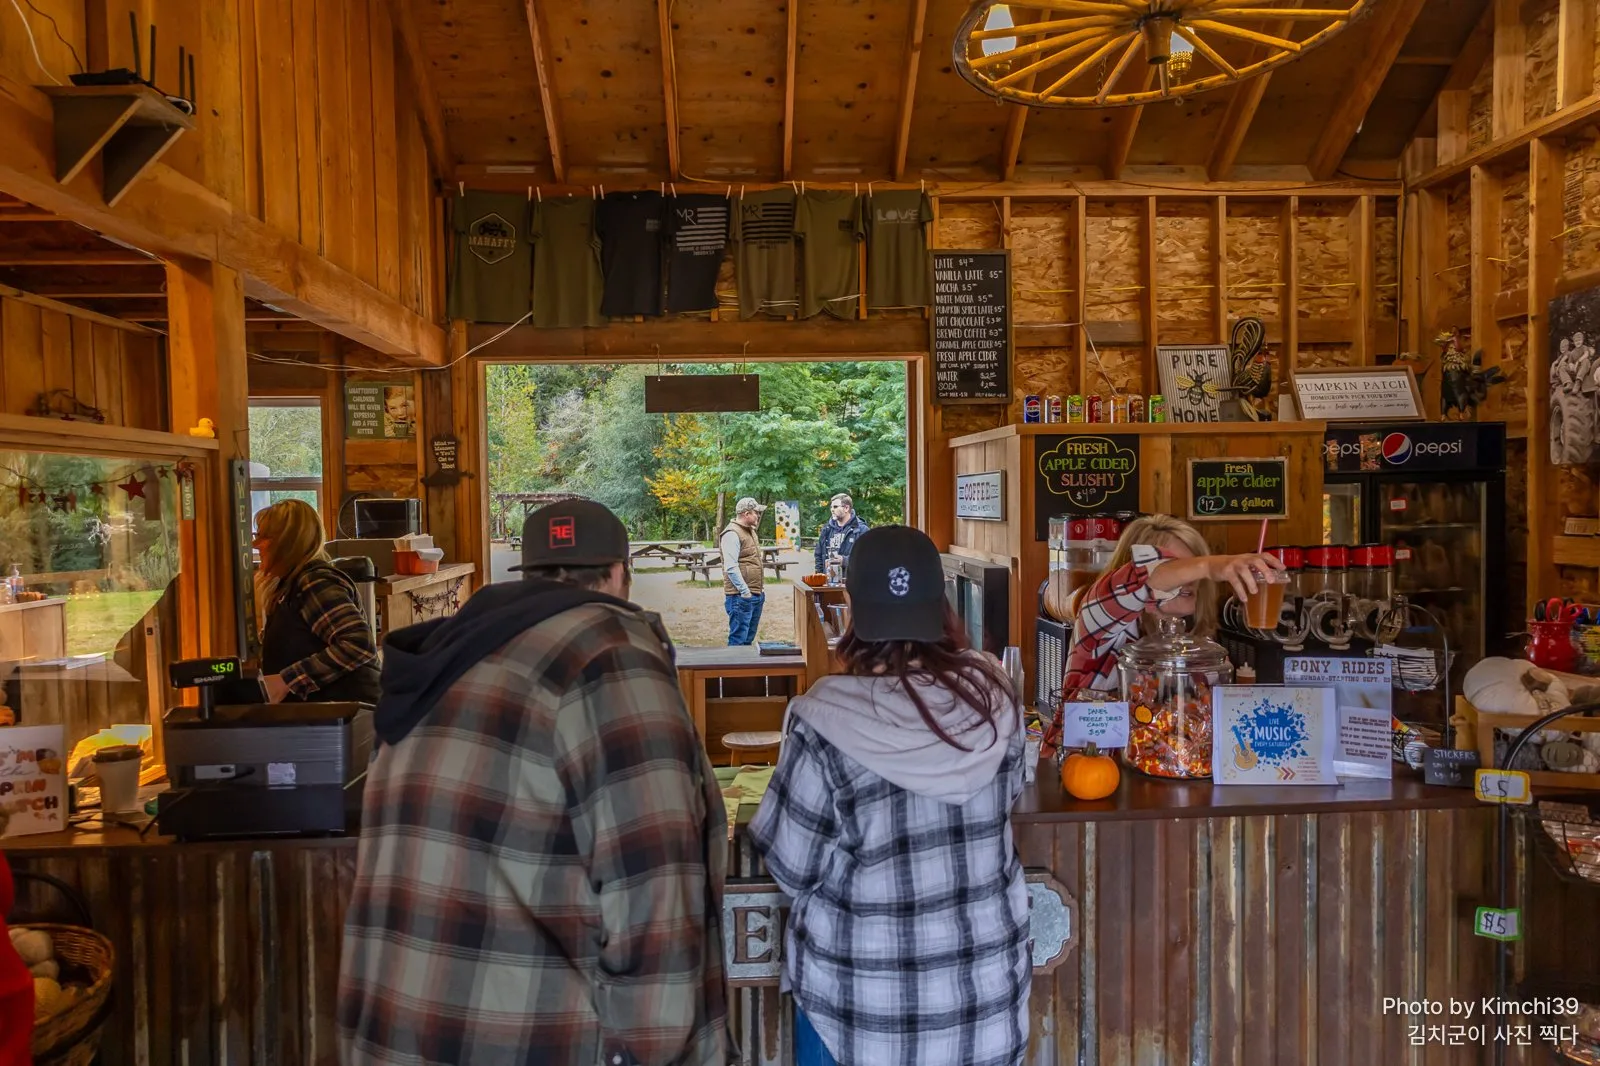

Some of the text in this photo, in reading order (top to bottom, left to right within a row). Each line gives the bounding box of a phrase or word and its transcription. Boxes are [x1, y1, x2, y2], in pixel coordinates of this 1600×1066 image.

[935, 258, 953, 269] LATTE
[935, 270, 962, 280] VANILLA
[965, 270, 983, 280] LATTE
[936, 283, 959, 293] MOCHA
[954, 295, 974, 303] MOCHA
[936, 305, 960, 315] PUMPKIN
[978, 305, 994, 314] LATTE
[937, 316, 948, 327] HOT
[950, 316, 985, 328] CHOCOLATE
[937, 328, 962, 338] BREWED
[964, 328, 986, 338] COFFEE
[961, 340, 977, 349] APPLE
[978, 340, 993, 349] CIDER
[937, 351, 997, 362] FRESH APPLE CIDER
[1172, 354, 1218, 368] PURE
[937, 371, 958, 381] WATER
[1296, 380, 1407, 392] PUMPKIN PATCH
[1066, 443, 1108, 455] FRESH
[1415, 439, 1462, 456] pepsi
[1045, 458, 1129, 470] APPLE CIDER
[1225, 464, 1253, 473] Fresh
[1061, 473, 1116, 486] SLUSHY
[1197, 475, 1280, 496] apple cider
[965, 482, 990, 501] COFFEE
[1201, 498, 1219, 511] $12
[1241, 497, 1274, 511] gallon
[237, 481, 255, 642] WELCOME
[1292, 660, 1384, 674] PONY RIDES
[1255, 727, 1291, 740] MUSIC
[1433, 750, 1476, 760] STICKERS
[1480, 776, 1509, 798] $5
[1481, 912, 1505, 934] $5
